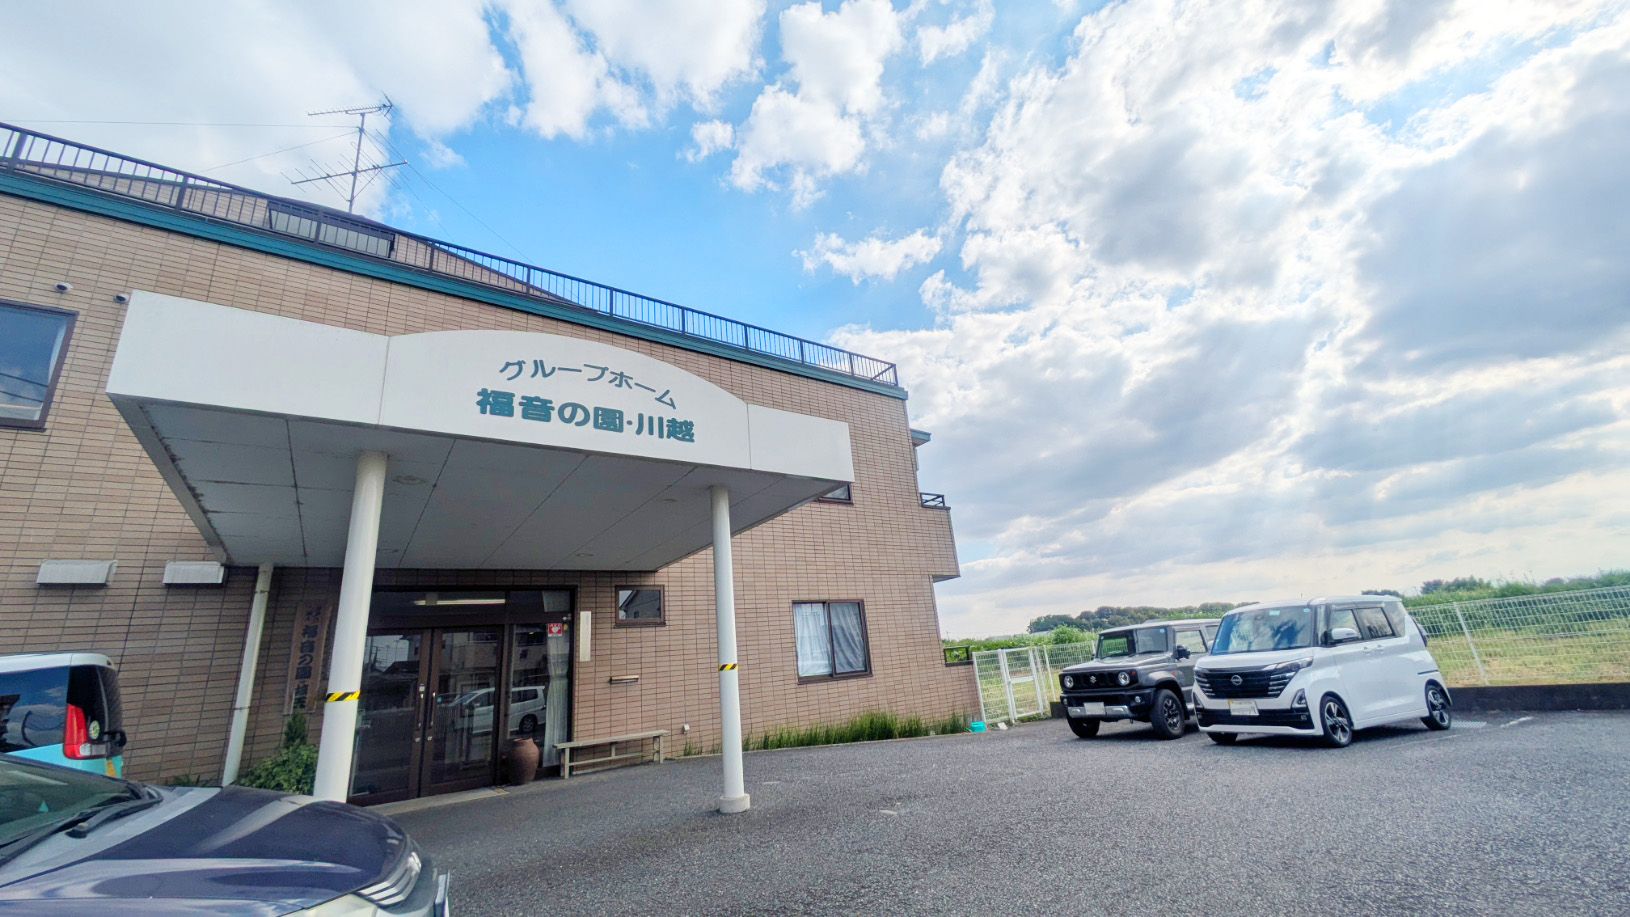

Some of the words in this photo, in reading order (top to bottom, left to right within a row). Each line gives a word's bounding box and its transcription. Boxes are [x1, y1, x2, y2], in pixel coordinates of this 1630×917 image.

[499, 359, 676, 410] グループホーム
[476, 387, 695, 443] 福音の園・川越
